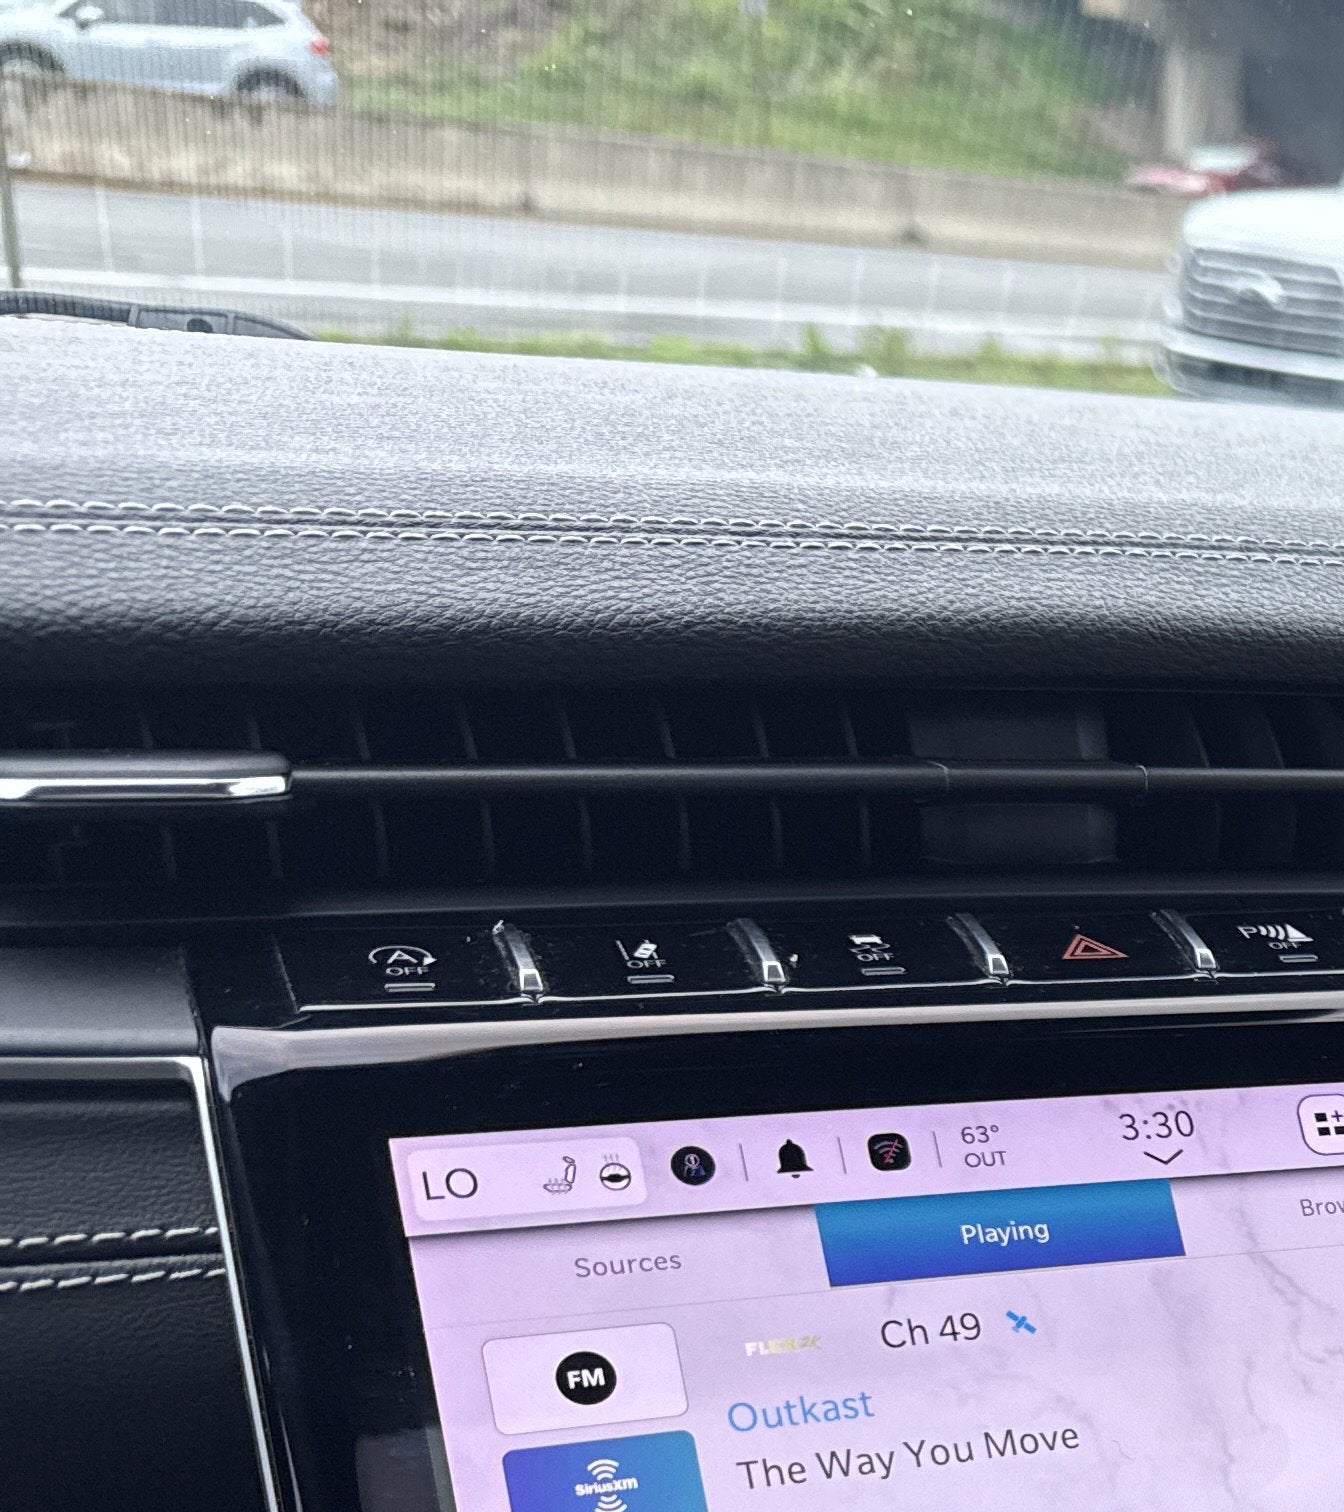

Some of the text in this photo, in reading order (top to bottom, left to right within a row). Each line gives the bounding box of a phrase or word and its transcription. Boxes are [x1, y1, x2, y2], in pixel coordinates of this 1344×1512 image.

[627, 959, 669, 970] OFF
[857, 952, 895, 963] OFF
[385, 967, 430, 978] OFF
[960, 1125, 1000, 1146] 63°
[1119, 1110, 1195, 1142] 3:30
[964, 1150, 1007, 1169] OUT
[422, 1166, 479, 1201] LO
[960, 1219, 1050, 1248] Playing
[573, 1249, 683, 1279] Sources
[880, 1312, 982, 1349] Ch 49
[566, 1367, 605, 1392] FM
[727, 1390, 876, 1434] Outkast
[736, 1426, 1080, 1490] The Way You Move
